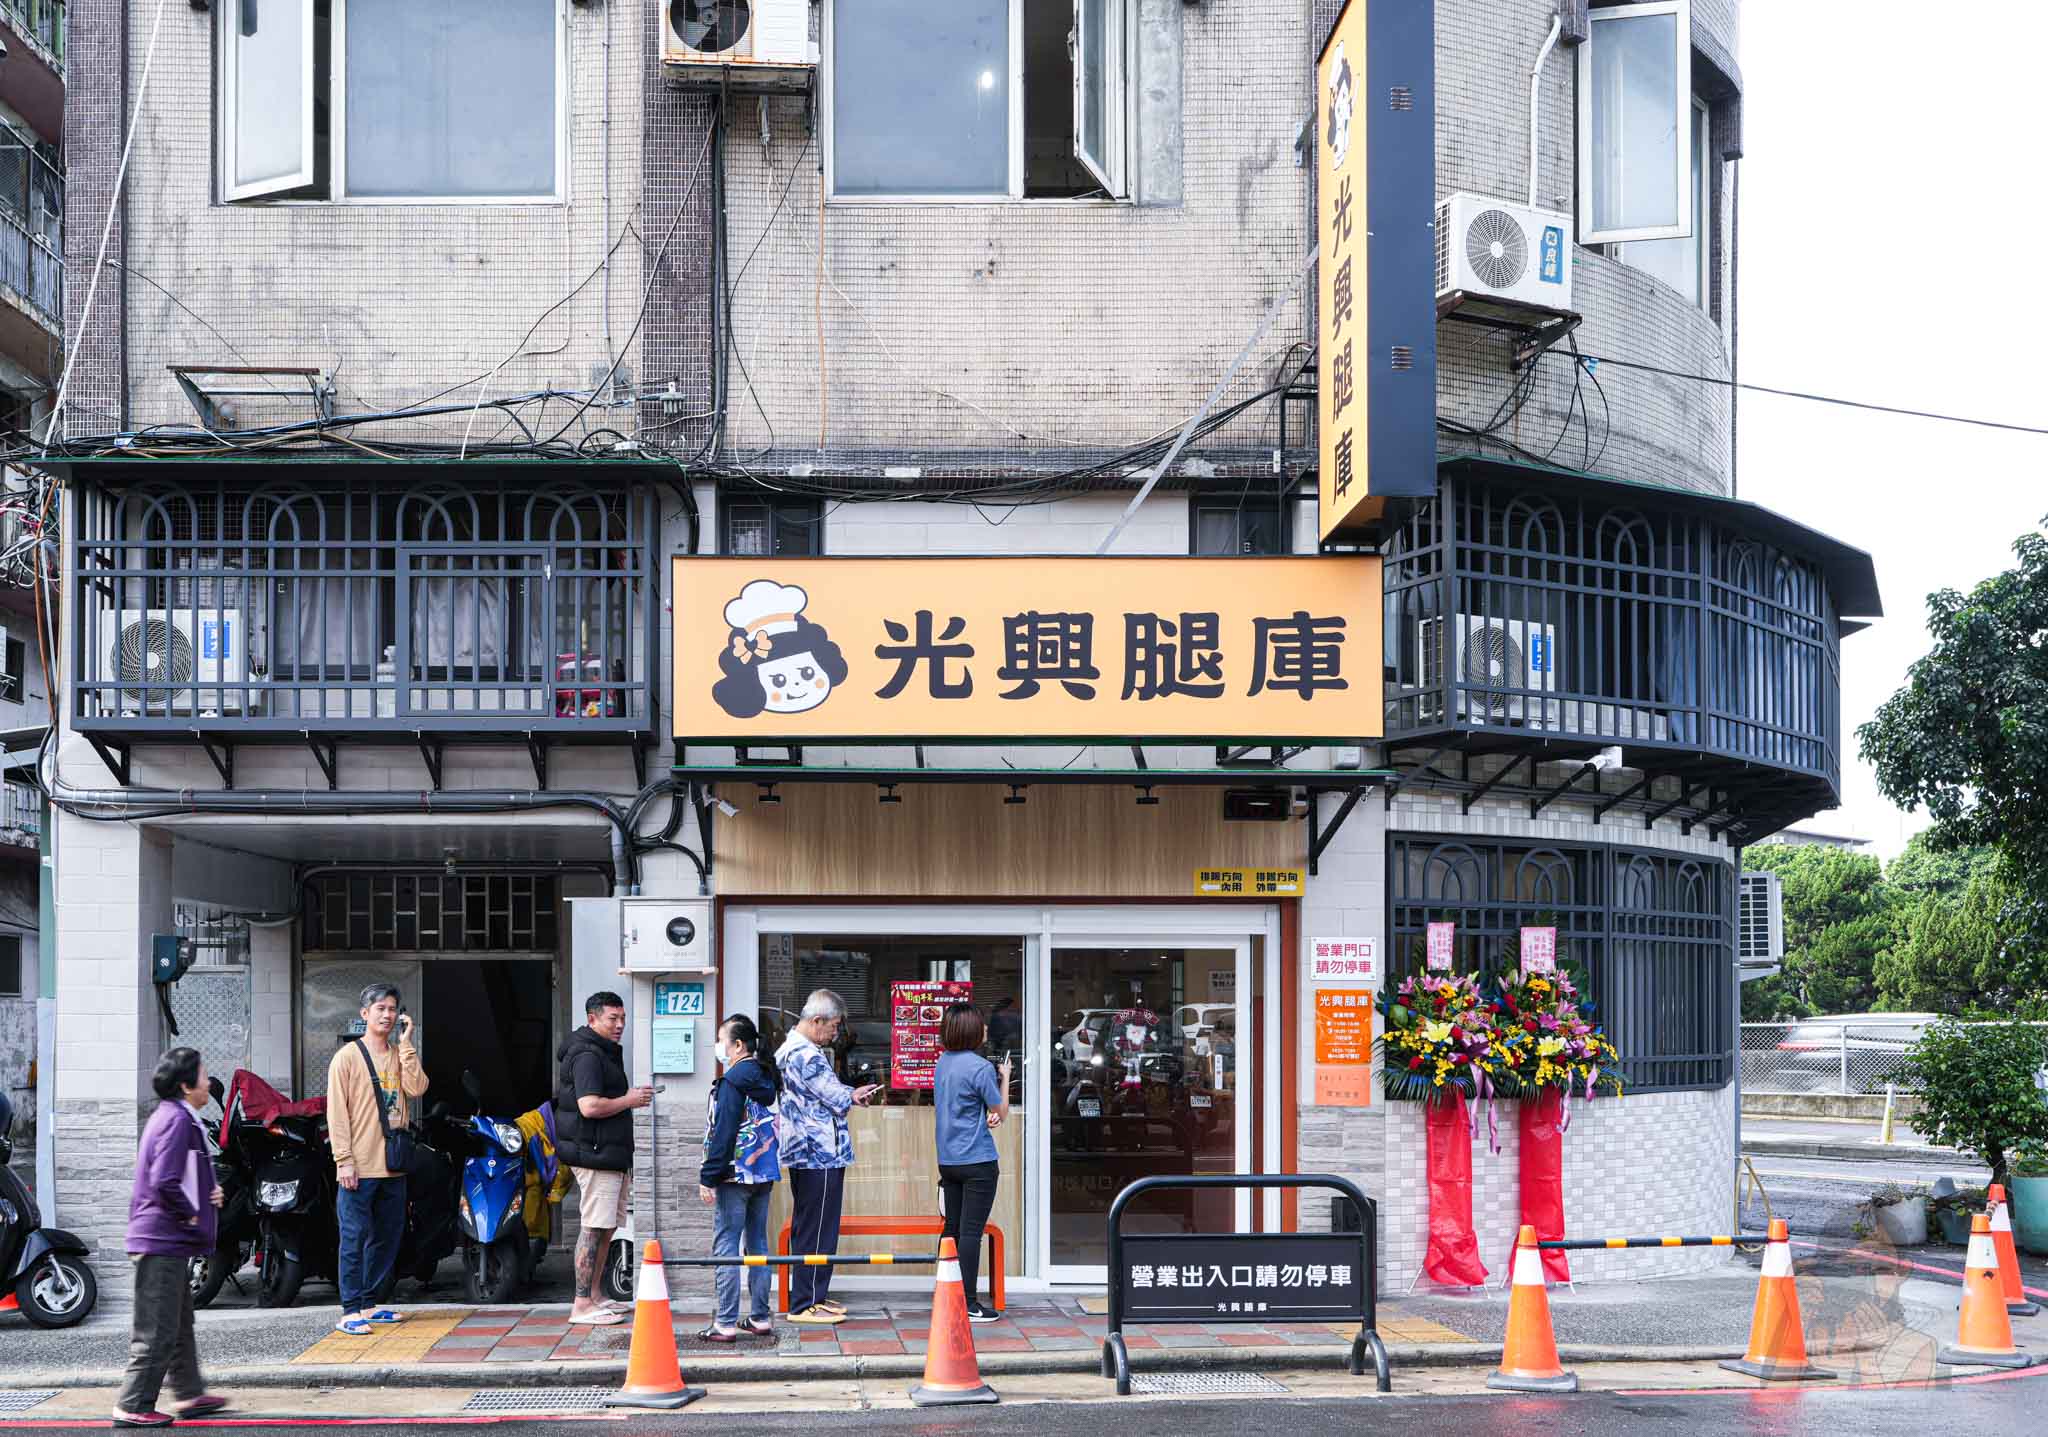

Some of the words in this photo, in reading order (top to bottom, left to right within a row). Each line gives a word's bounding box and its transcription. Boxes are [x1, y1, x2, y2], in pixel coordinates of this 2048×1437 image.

[1332, 175, 1353, 505] 光興腿庫
[874, 609, 1350, 701] 光興腿庫
[1316, 943, 1371, 957] 營業門口
[1316, 960, 1372, 974] 請勿停車
[671, 993, 701, 1012] 124
[1320, 995, 1368, 1007] 光興腿庫
[1131, 1265, 1352, 1288] 營業出入口請勿停車
